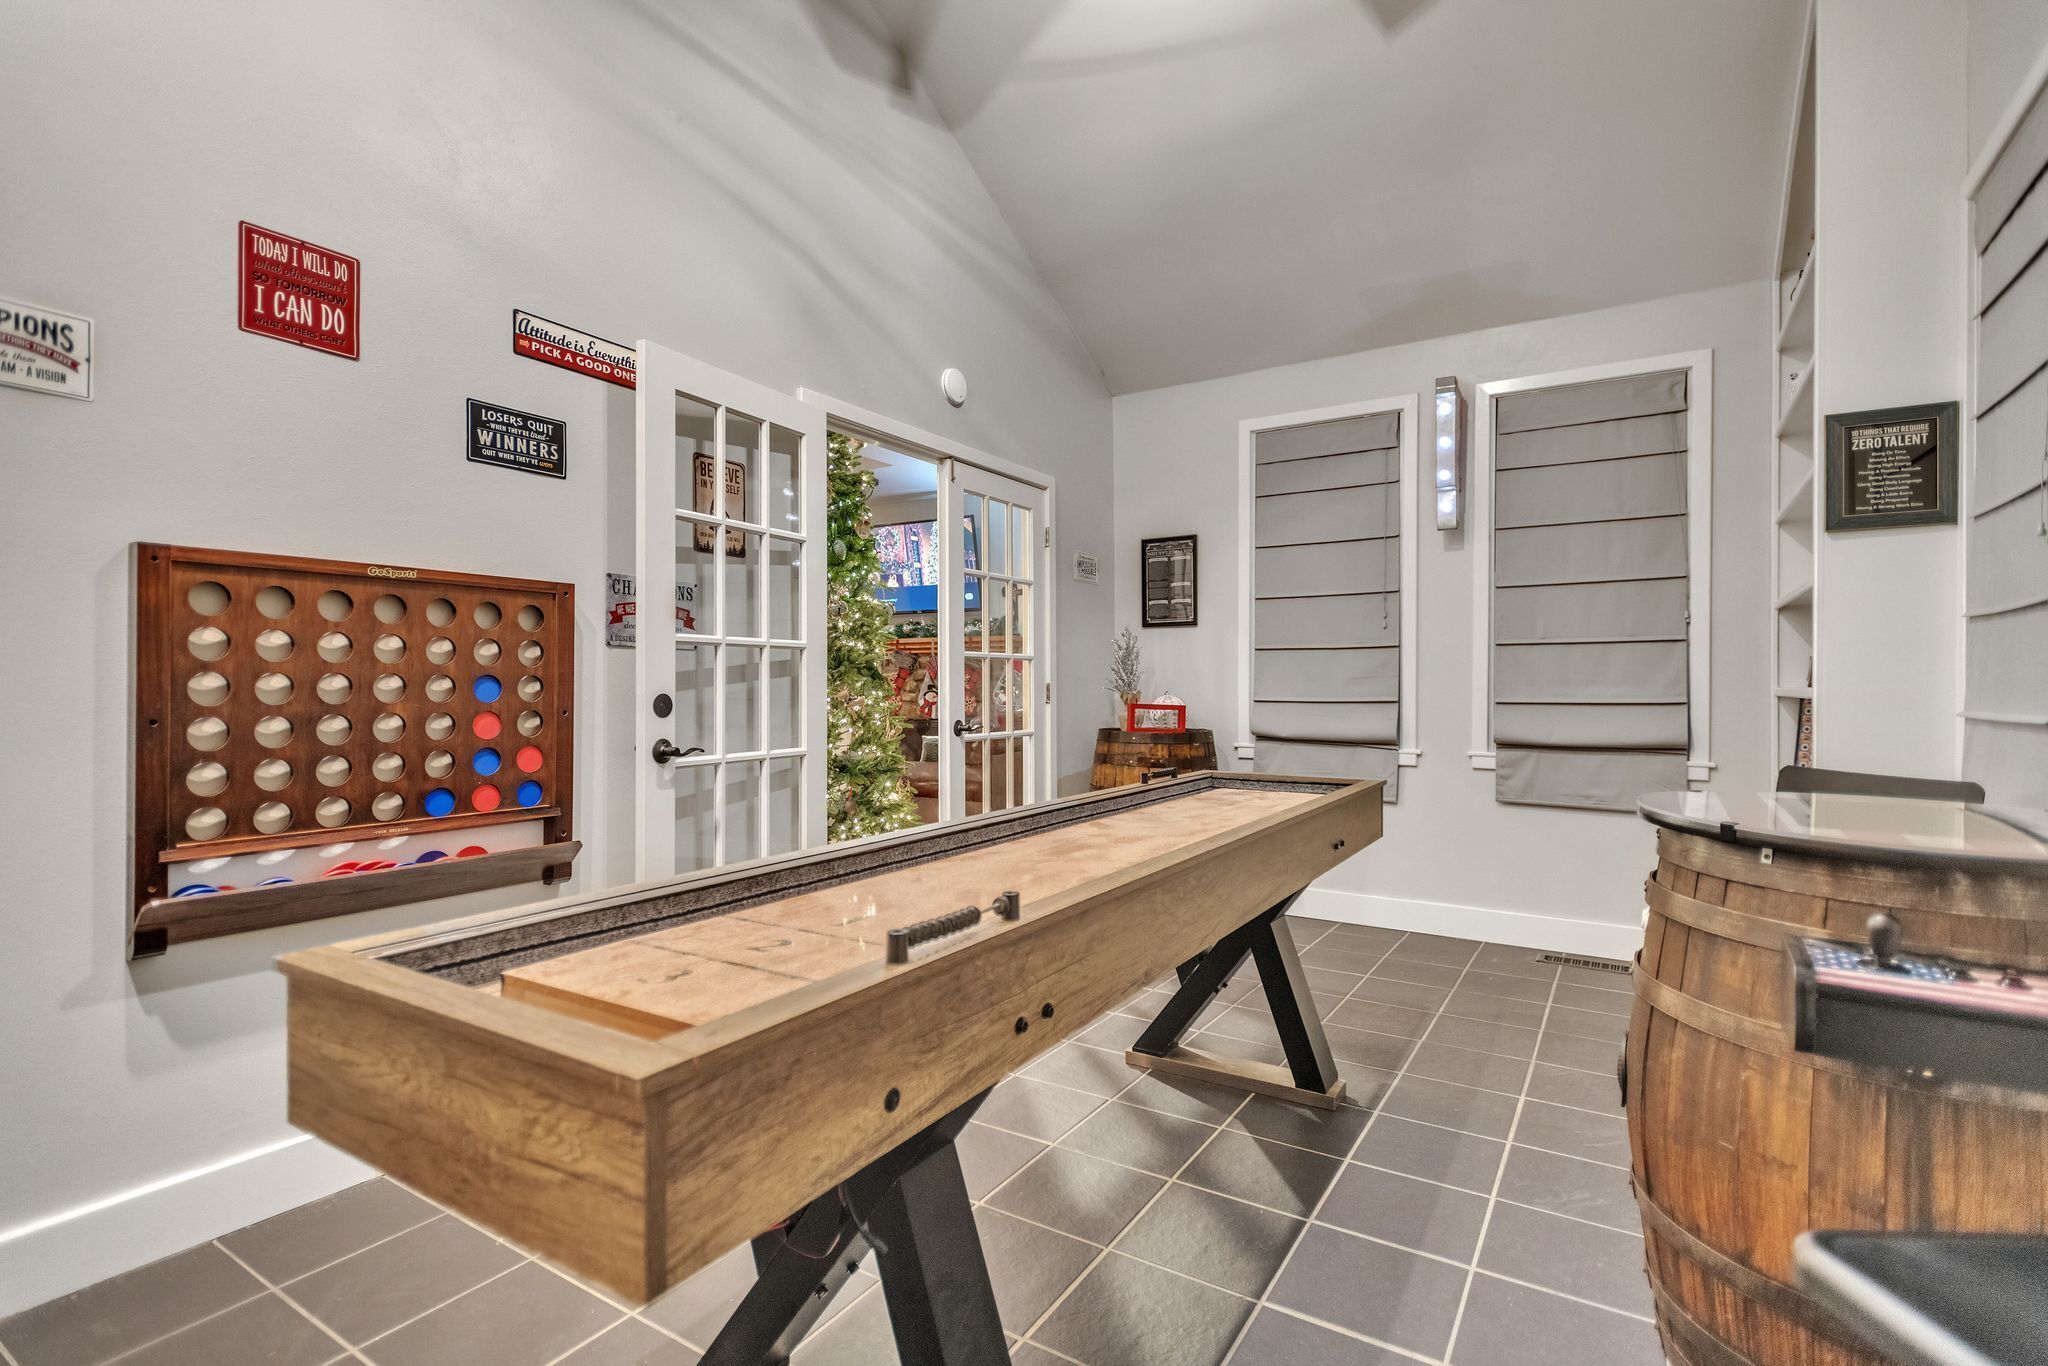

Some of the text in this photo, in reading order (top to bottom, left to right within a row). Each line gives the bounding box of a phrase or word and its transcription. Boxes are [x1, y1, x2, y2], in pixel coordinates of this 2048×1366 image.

[252, 233, 348, 282] TODAY I WILL DO
[252, 270, 347, 306] SO TOMORROW
[254, 284, 345, 335] I CAN DO
[0, 308, 74, 353] PIONS
[253, 316, 281, 328] WHAT
[284, 323, 318, 339] OTHERS
[0, 334, 72, 366] ETHING THEY HAVE
[518, 317, 636, 370] Attitude is Everythi
[1, 361, 67, 384] AM A VISION
[531, 341, 636, 382] PICK A GOOD ONE
[482, 408, 554, 436] LOSERS QUIT
[1859, 427, 1883, 436] THINGS
[1883, 426, 1900, 434] THAT
[1900, 423, 1930, 432] REQUIRE
[477, 428, 558, 460] WINNERS
[482, 448, 496, 457] QUIT
[498, 452, 515, 461] WHEN
[1851, 433, 1929, 451] ZERO TALENT
[700, 460, 740, 485] BEVE
[700, 478, 740, 496] IN YSELF
[367, 566, 416, 578] GoSports
